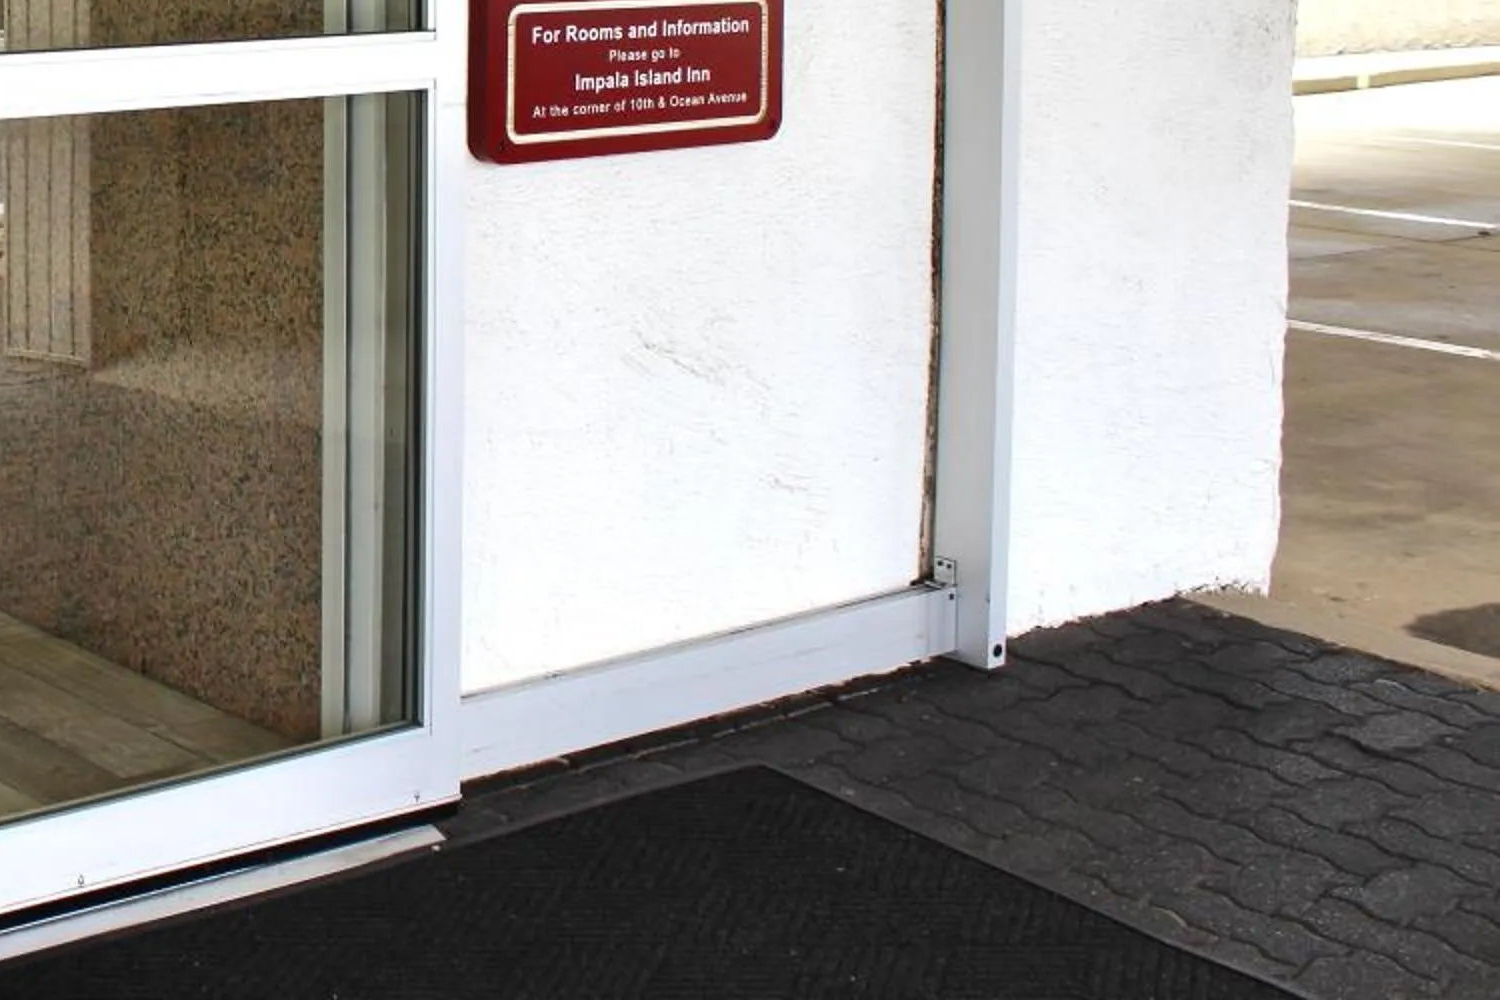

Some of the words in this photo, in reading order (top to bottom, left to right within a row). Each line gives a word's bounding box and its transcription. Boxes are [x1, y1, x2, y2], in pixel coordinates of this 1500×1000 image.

[532, 26, 560, 44] For
[566, 23, 622, 42] Rooms
[628, 20, 657, 40] and
[663, 16, 749, 37] Information
[609, 48, 647, 62] Please
[652, 50, 665, 62] go
[669, 48, 680, 59] to
[575, 72, 629, 93] Impala
[635, 70, 681, 88] Island
[687, 68, 710, 83] Inn
[532, 106, 546, 118] At
[550, 104, 569, 116] the
[573, 102, 610, 116] corner
[614, 99, 626, 112] of
[630, 98, 654, 110] 10th
[658, 96, 665, 108] &
[670, 94, 704, 108] Ocean
[708, 91, 747, 104] Avenue
